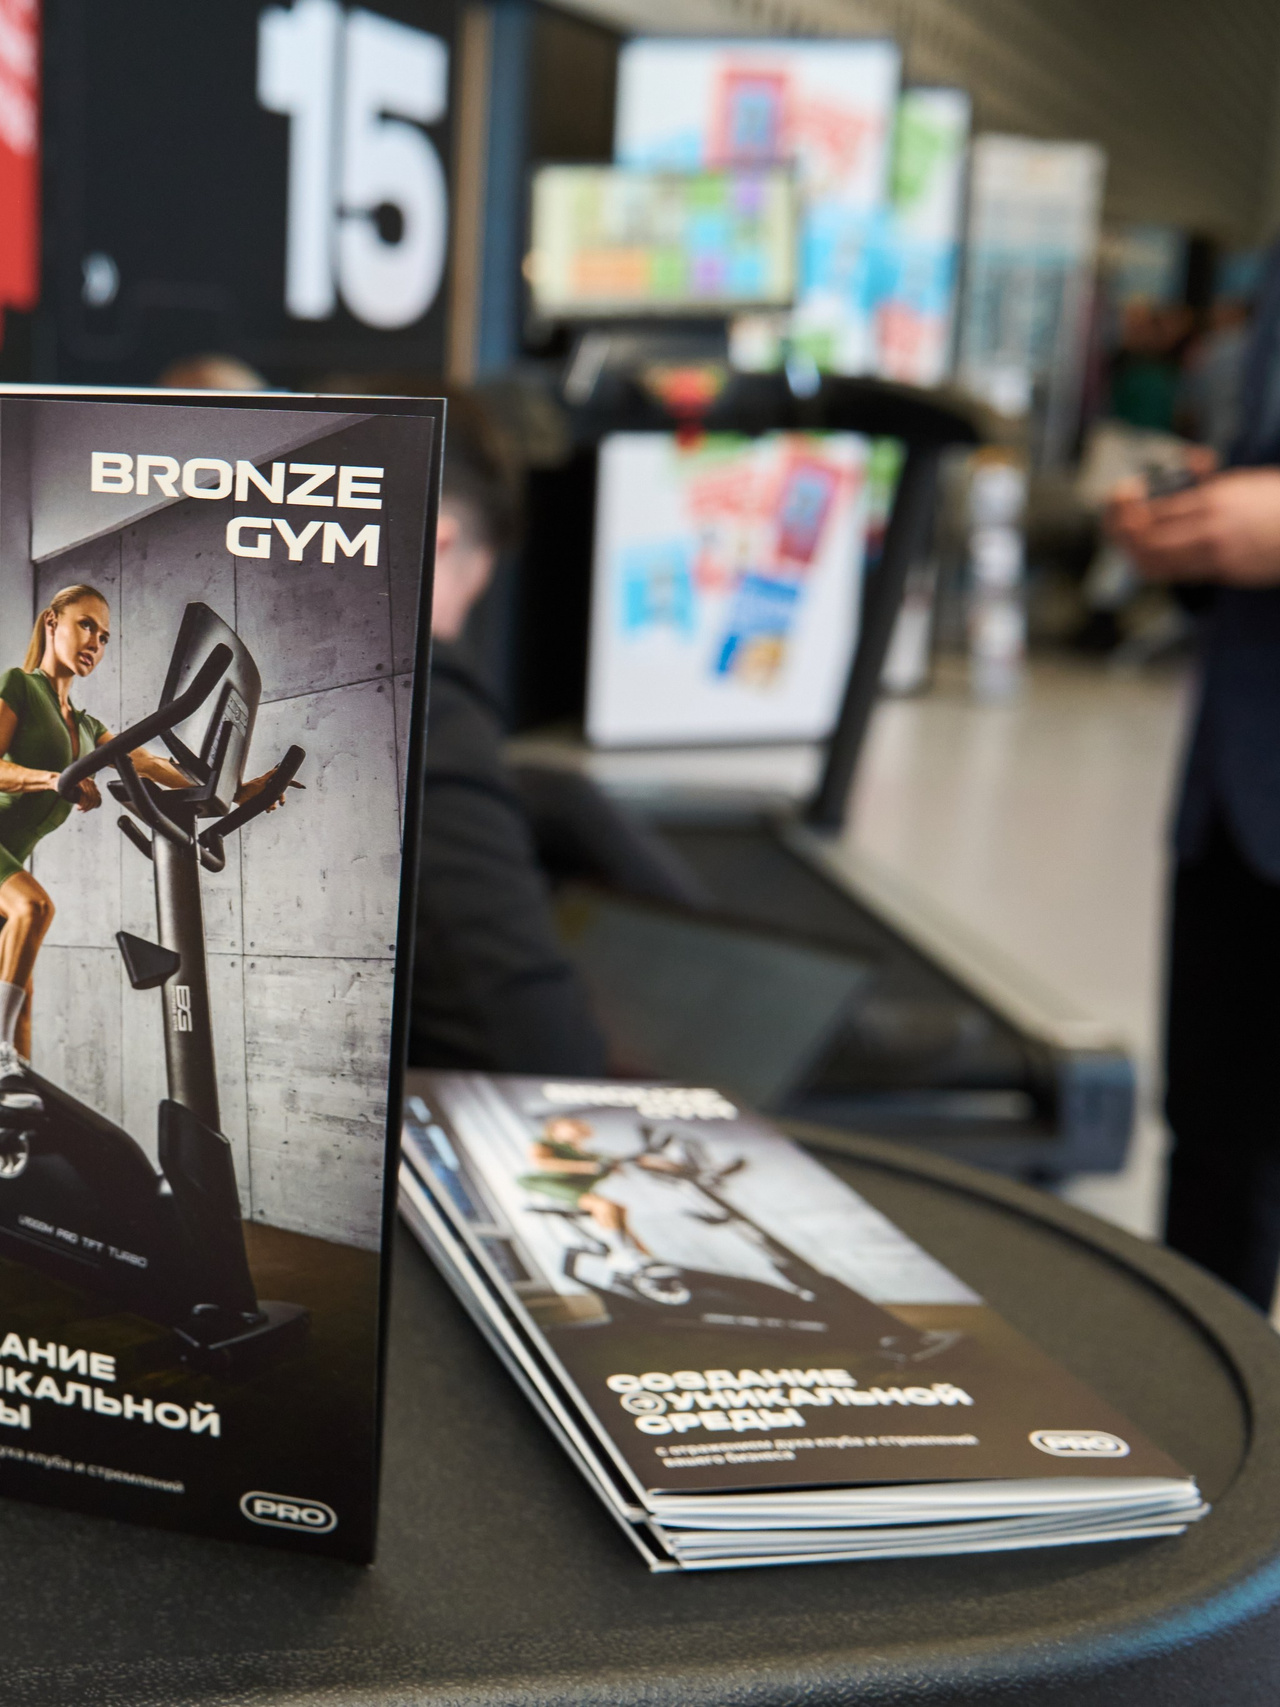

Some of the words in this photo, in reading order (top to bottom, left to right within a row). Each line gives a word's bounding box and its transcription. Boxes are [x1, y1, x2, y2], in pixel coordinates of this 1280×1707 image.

[257, 0, 449, 331] 15
[91, 451, 384, 510] BRONZE
[226, 516, 381, 567] GYM
[107, 1245, 149, 1269] TURBO
[606, 1369, 858, 1393] СОЗДАНИЕ
[664, 1383, 974, 1411] УНИКАЛЬНОЙ
[635, 1408, 807, 1435] СРЕДЫ
[253, 1499, 327, 1526] PRO
